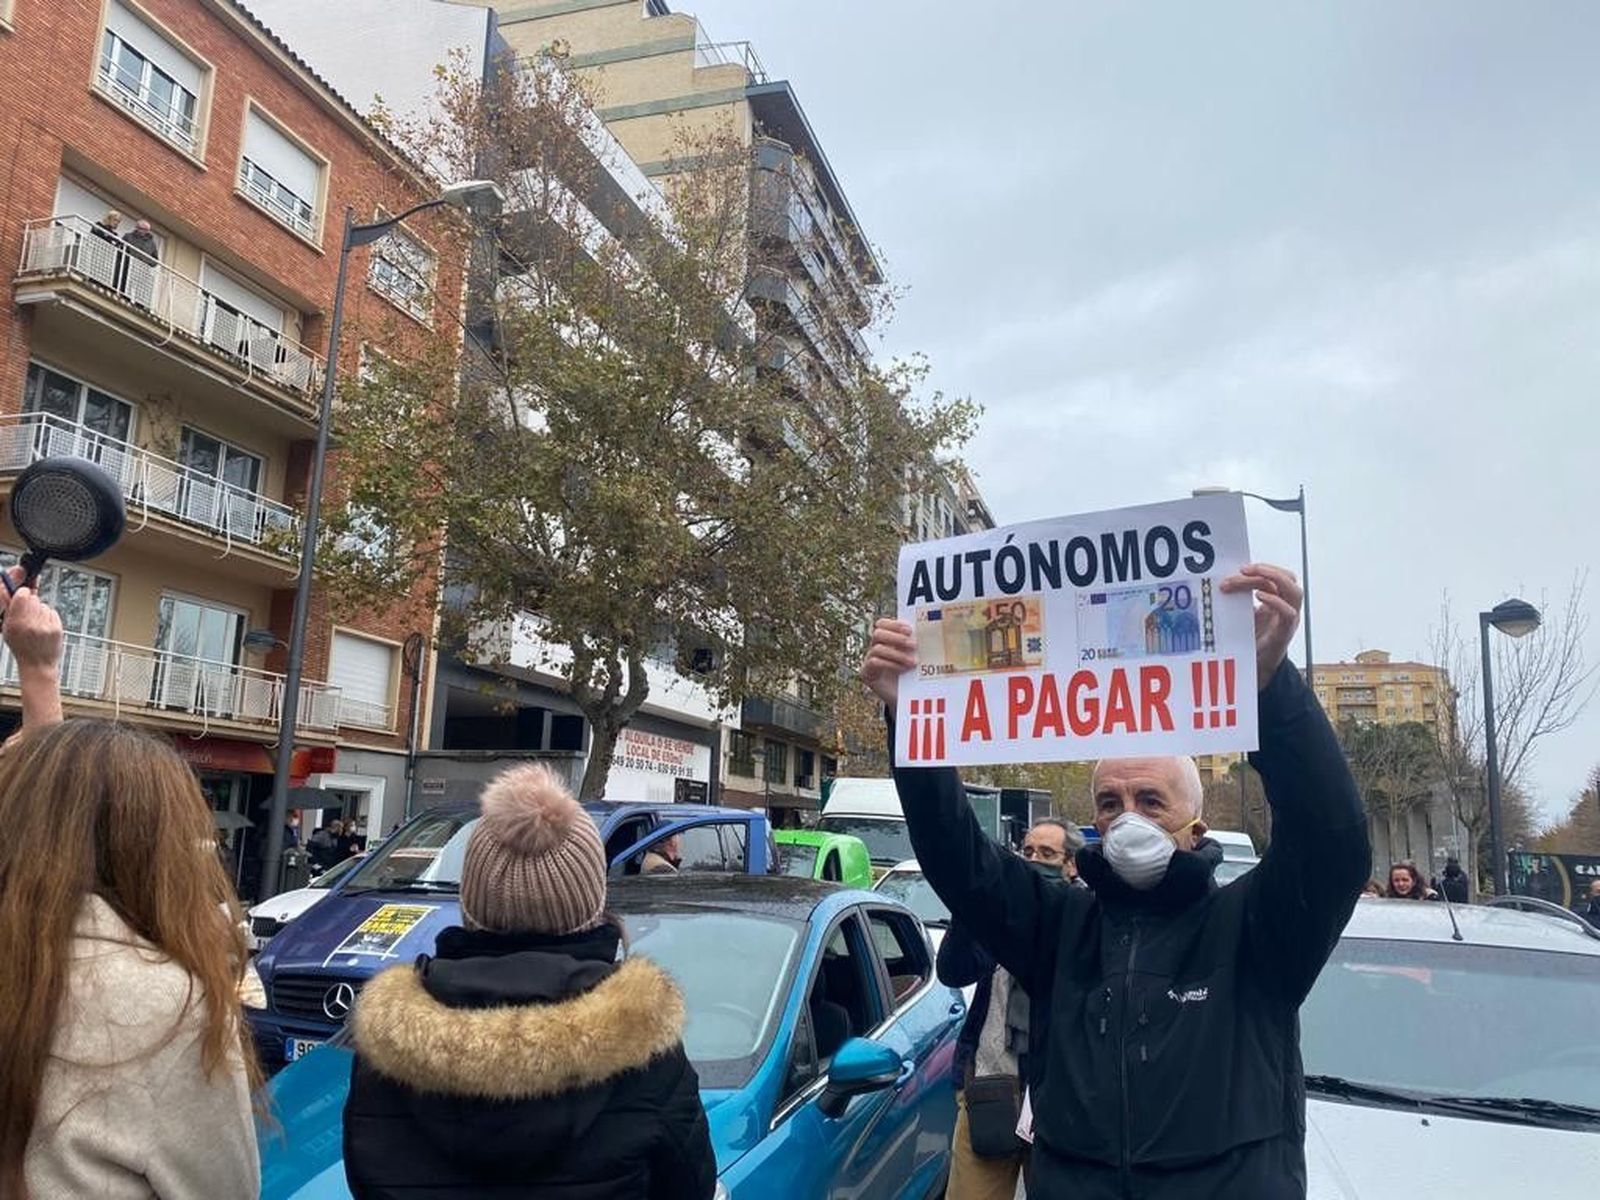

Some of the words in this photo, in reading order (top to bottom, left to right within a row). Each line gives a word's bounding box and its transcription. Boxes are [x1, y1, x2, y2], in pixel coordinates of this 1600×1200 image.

[907, 520, 1216, 606] AUTÓNOMOS
[960, 679, 993, 742] A
[1007, 664, 1175, 740] PAGAR
[1191, 658, 1237, 729] !!!
[626, 743, 650, 760] LOCAL
[651, 748, 661, 761] DE
